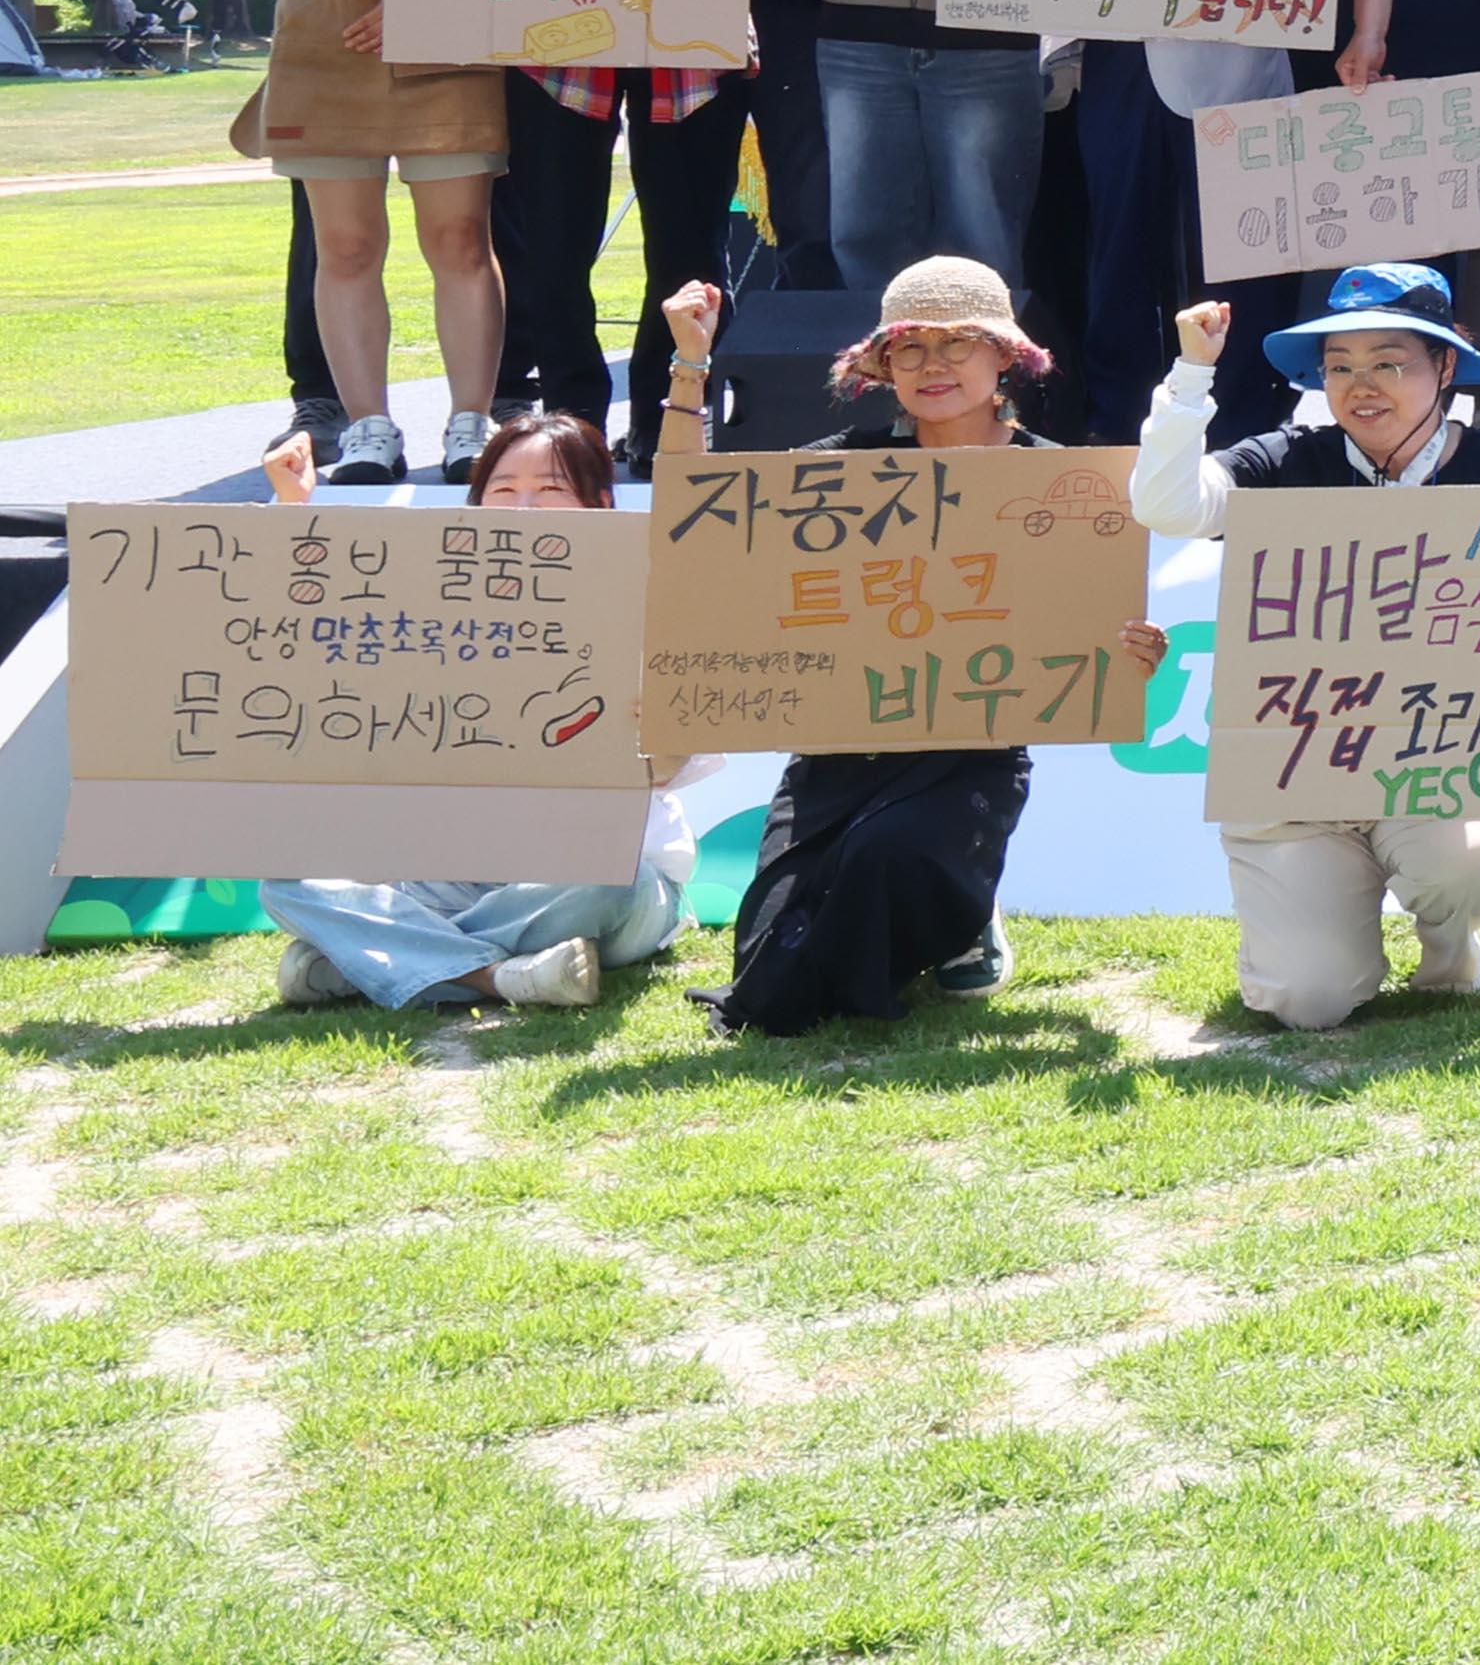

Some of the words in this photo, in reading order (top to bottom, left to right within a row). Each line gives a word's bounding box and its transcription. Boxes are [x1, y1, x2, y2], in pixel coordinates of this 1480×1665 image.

[669, 455, 960, 554] 자동차
[90, 524, 253, 603] 기관
[288, 516, 388, 604] 홍보
[437, 527, 573, 602] 물품은
[778, 552, 1010, 638] 트렁크
[1248, 533, 1450, 643] 배달
[226, 617, 299, 661] 안성
[174, 671, 516, 762] 문의하세요.
[864, 645, 1111, 738] 비우기
[1255, 667, 1383, 789] 직접
